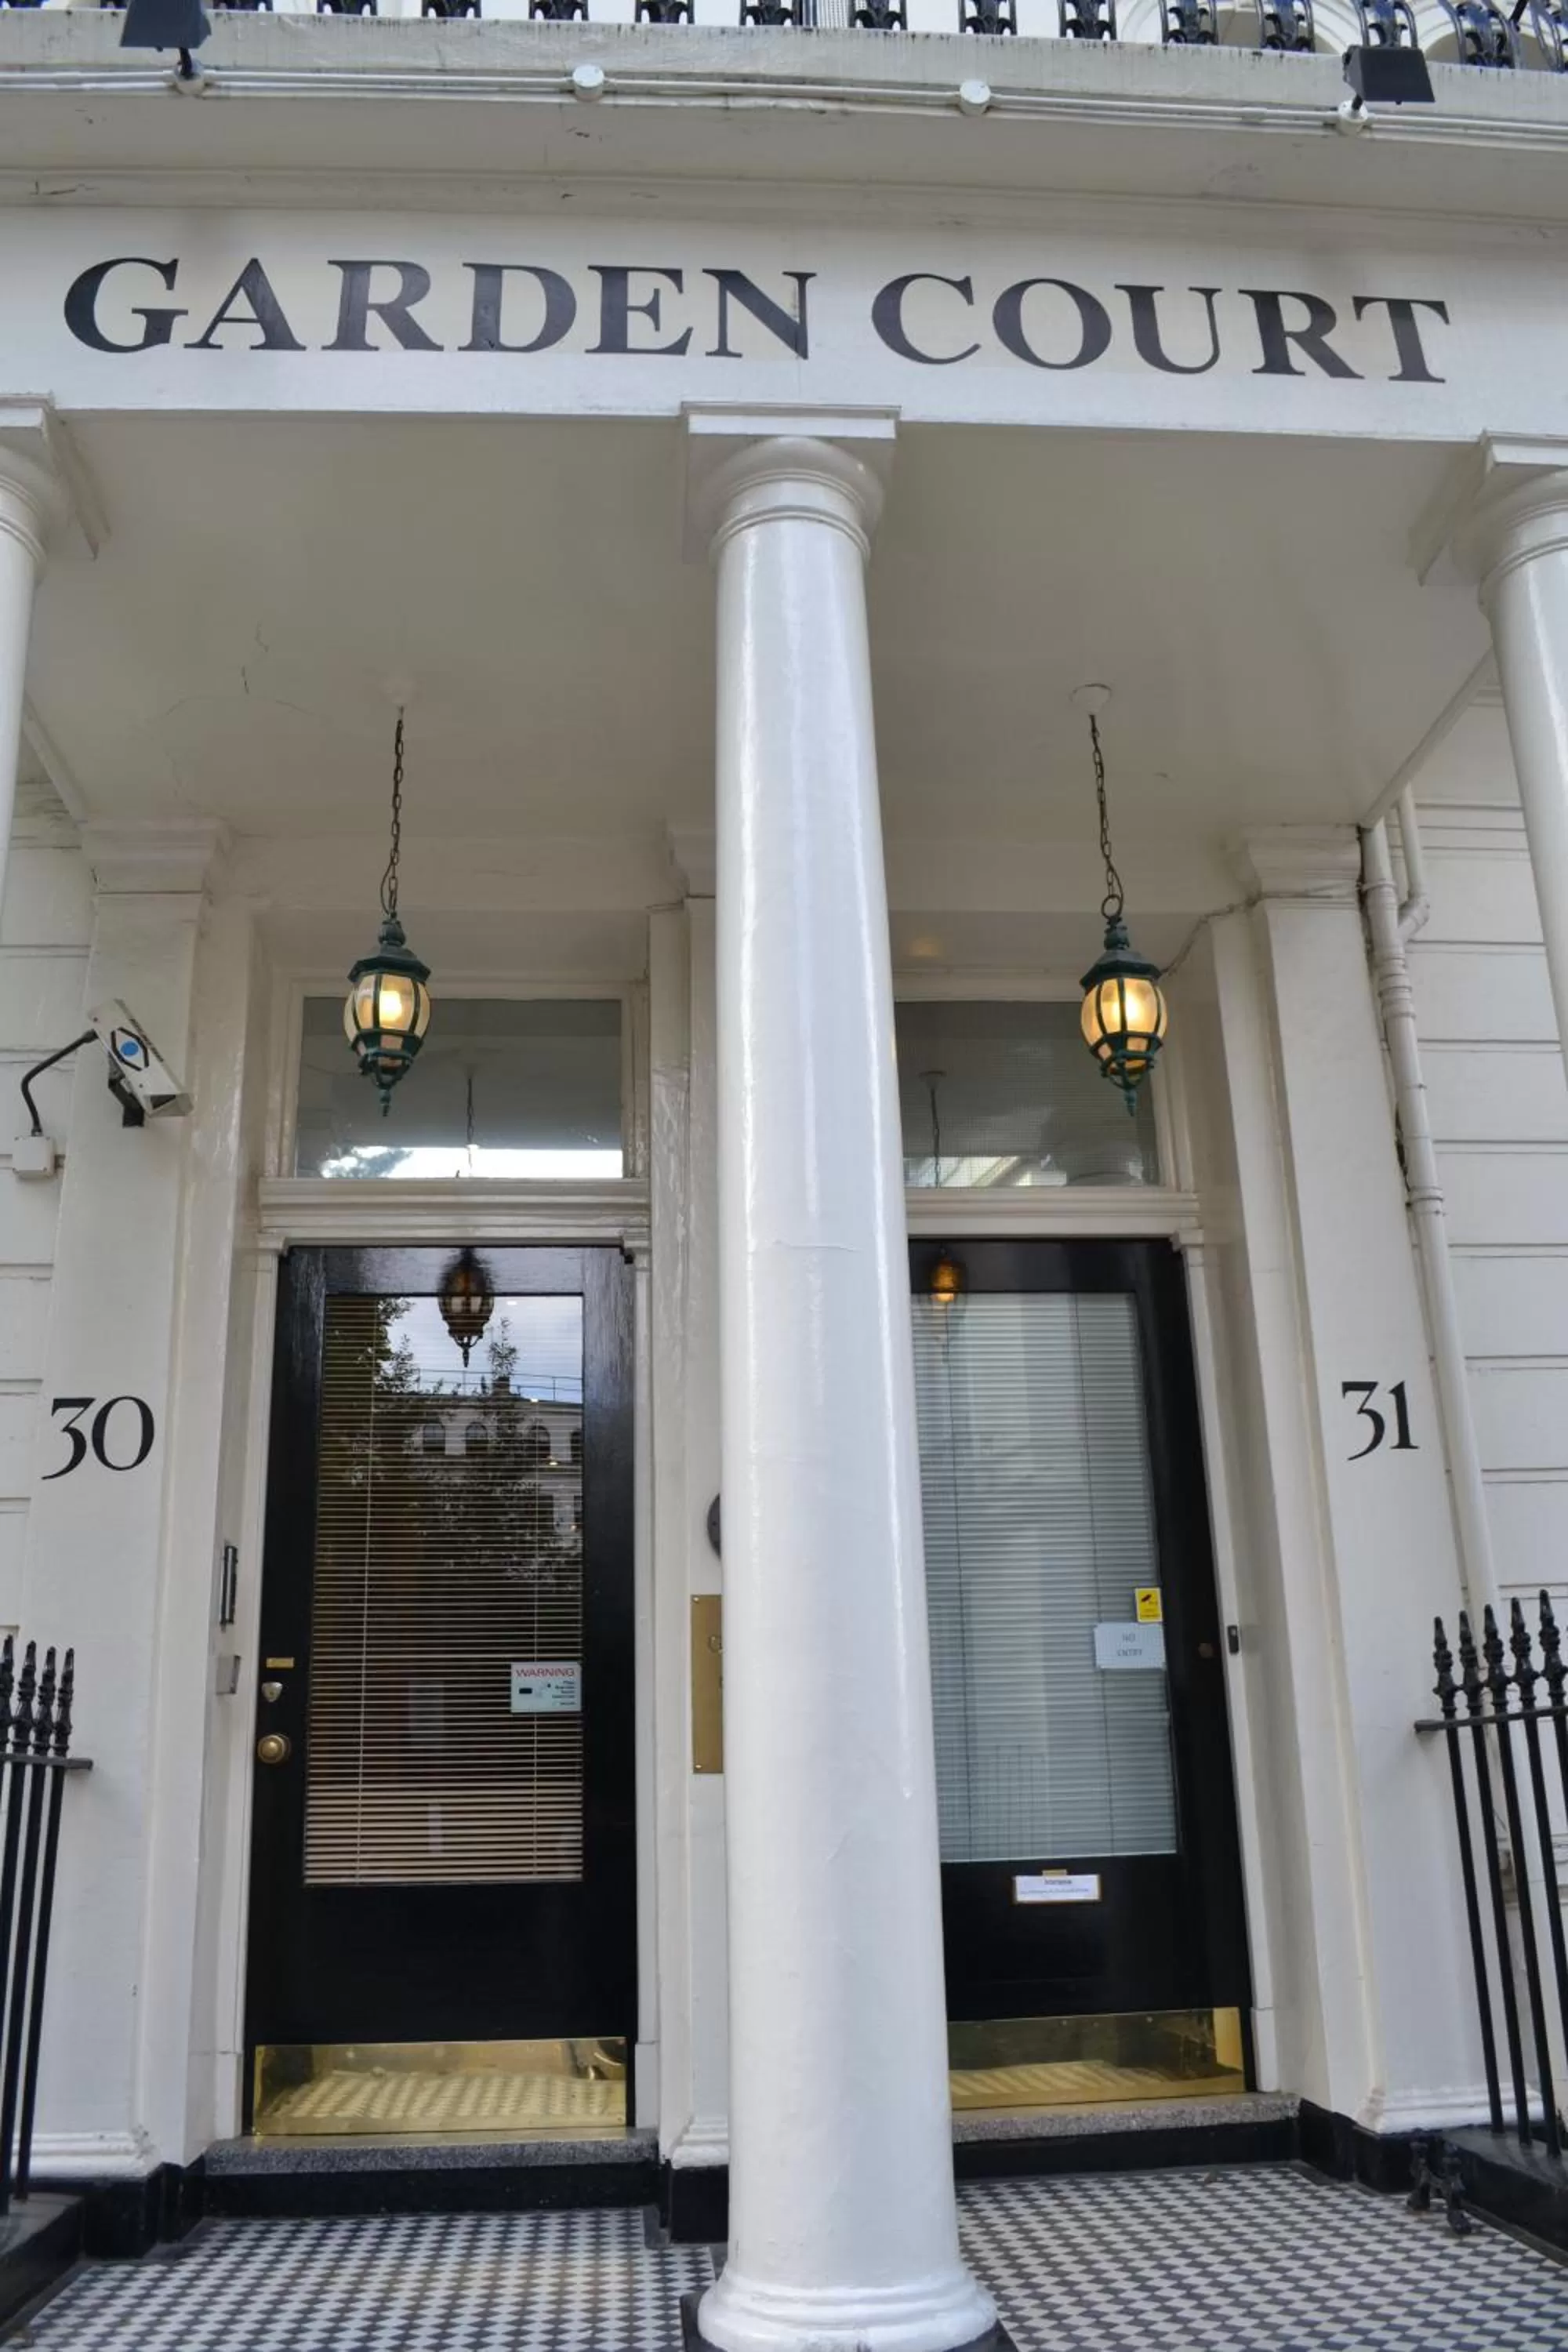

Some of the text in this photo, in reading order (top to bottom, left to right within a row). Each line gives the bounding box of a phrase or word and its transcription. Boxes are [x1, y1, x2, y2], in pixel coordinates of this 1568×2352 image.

[64, 256, 1450, 383] GARDEN COURT
[41, 1396, 154, 1480] 30
[1341, 1380, 1419, 1461] 31
[516, 1668, 575, 1677] WARNING
